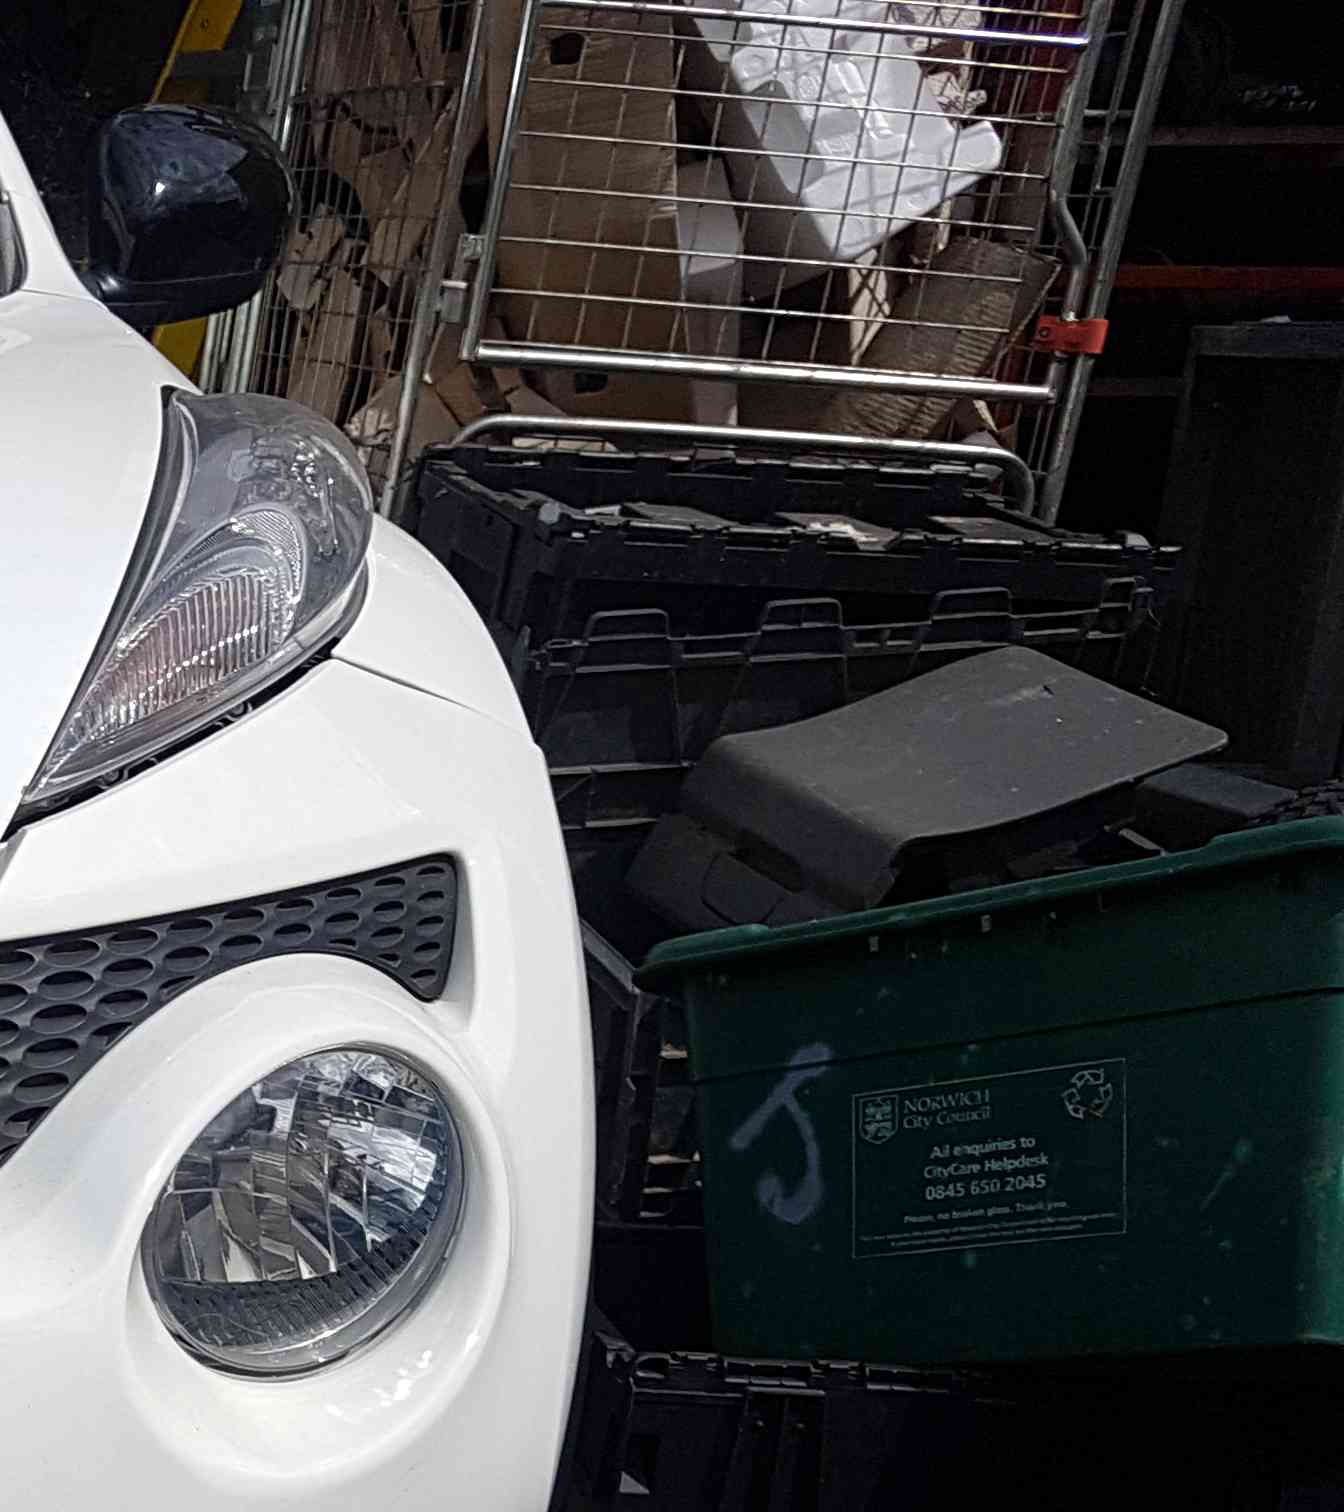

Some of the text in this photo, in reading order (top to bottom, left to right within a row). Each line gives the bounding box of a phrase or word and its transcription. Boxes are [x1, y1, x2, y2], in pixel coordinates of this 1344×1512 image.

[903, 1089, 990, 1114] NORWICH
[903, 1105, 992, 1130] City Council
[930, 1136, 1036, 1159] All enquiries to
[984, 1152, 1049, 1173] Helpdesk
[925, 1173, 1048, 1201] 0845 650 2045
